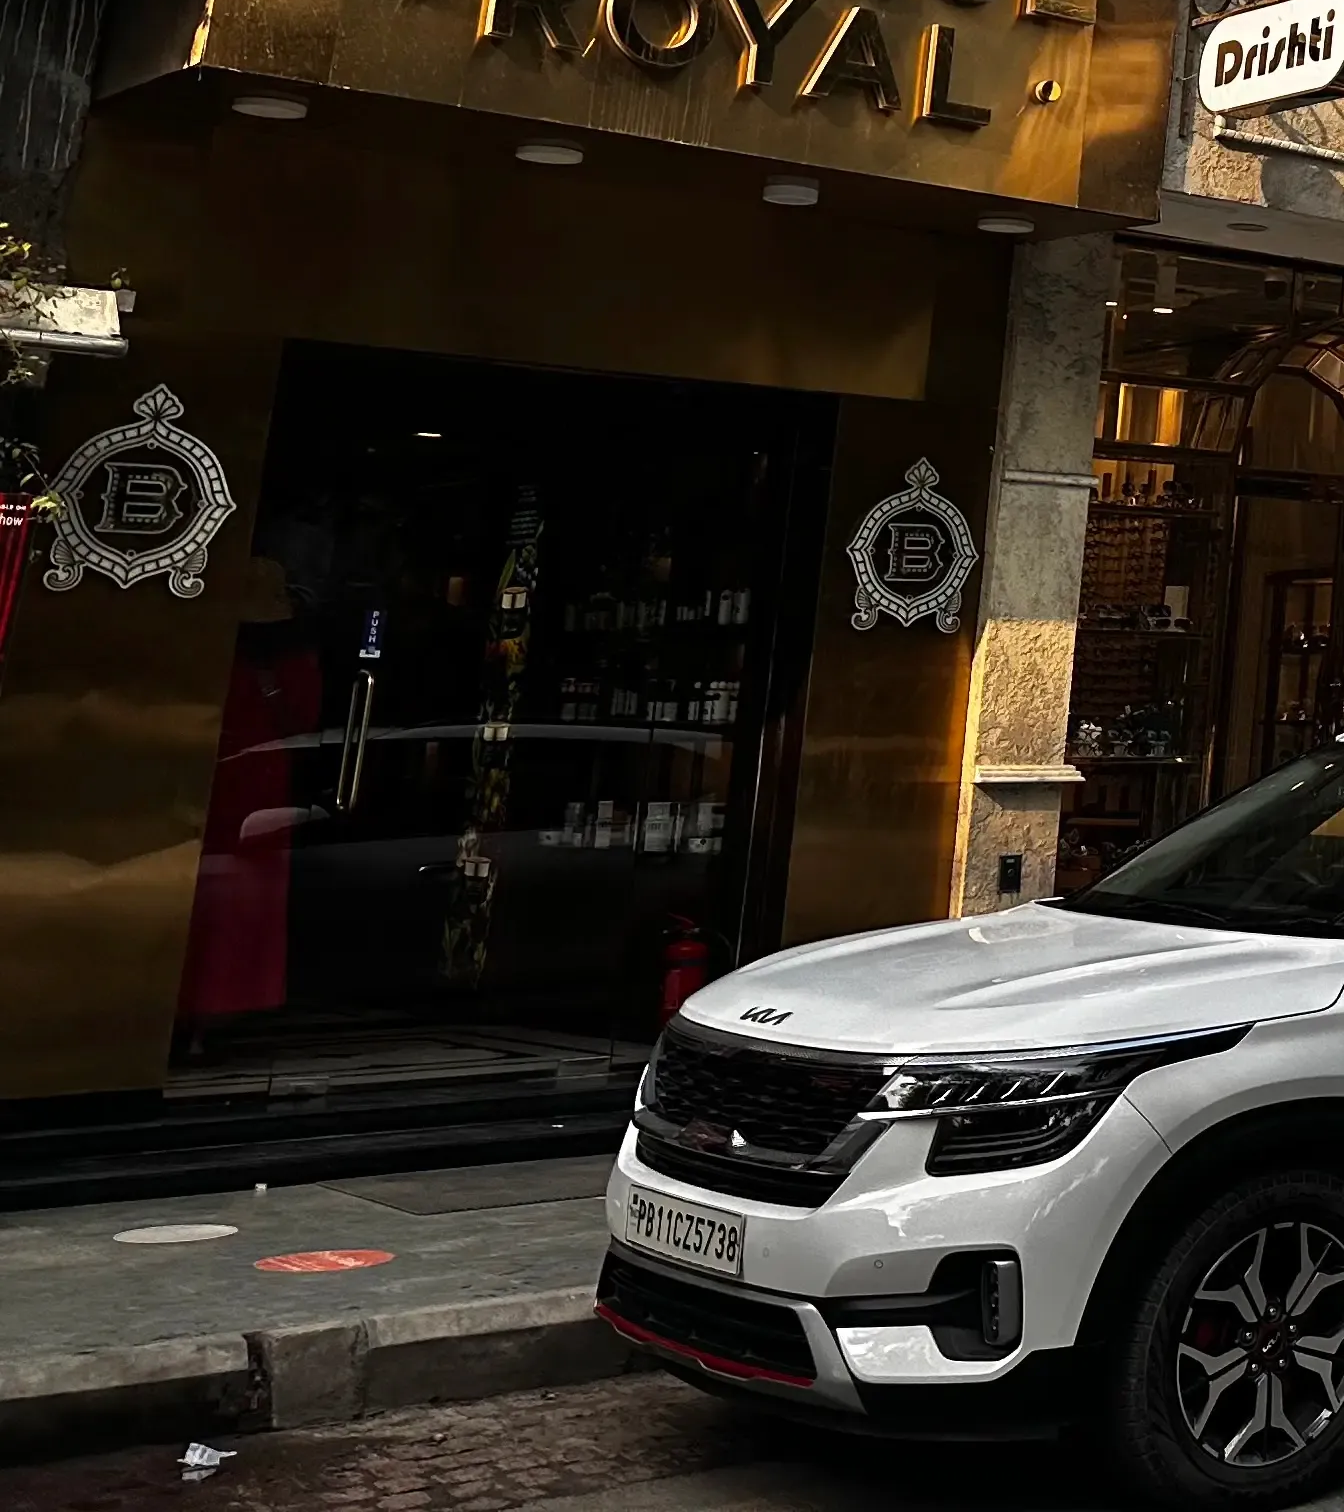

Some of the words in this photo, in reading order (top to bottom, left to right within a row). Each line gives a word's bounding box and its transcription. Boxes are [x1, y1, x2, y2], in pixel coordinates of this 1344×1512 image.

[1213, 7, 1337, 89] Drishti
[368, 610, 380, 643] PUSH
[636, 1192, 739, 1262] PB11CZ5738
